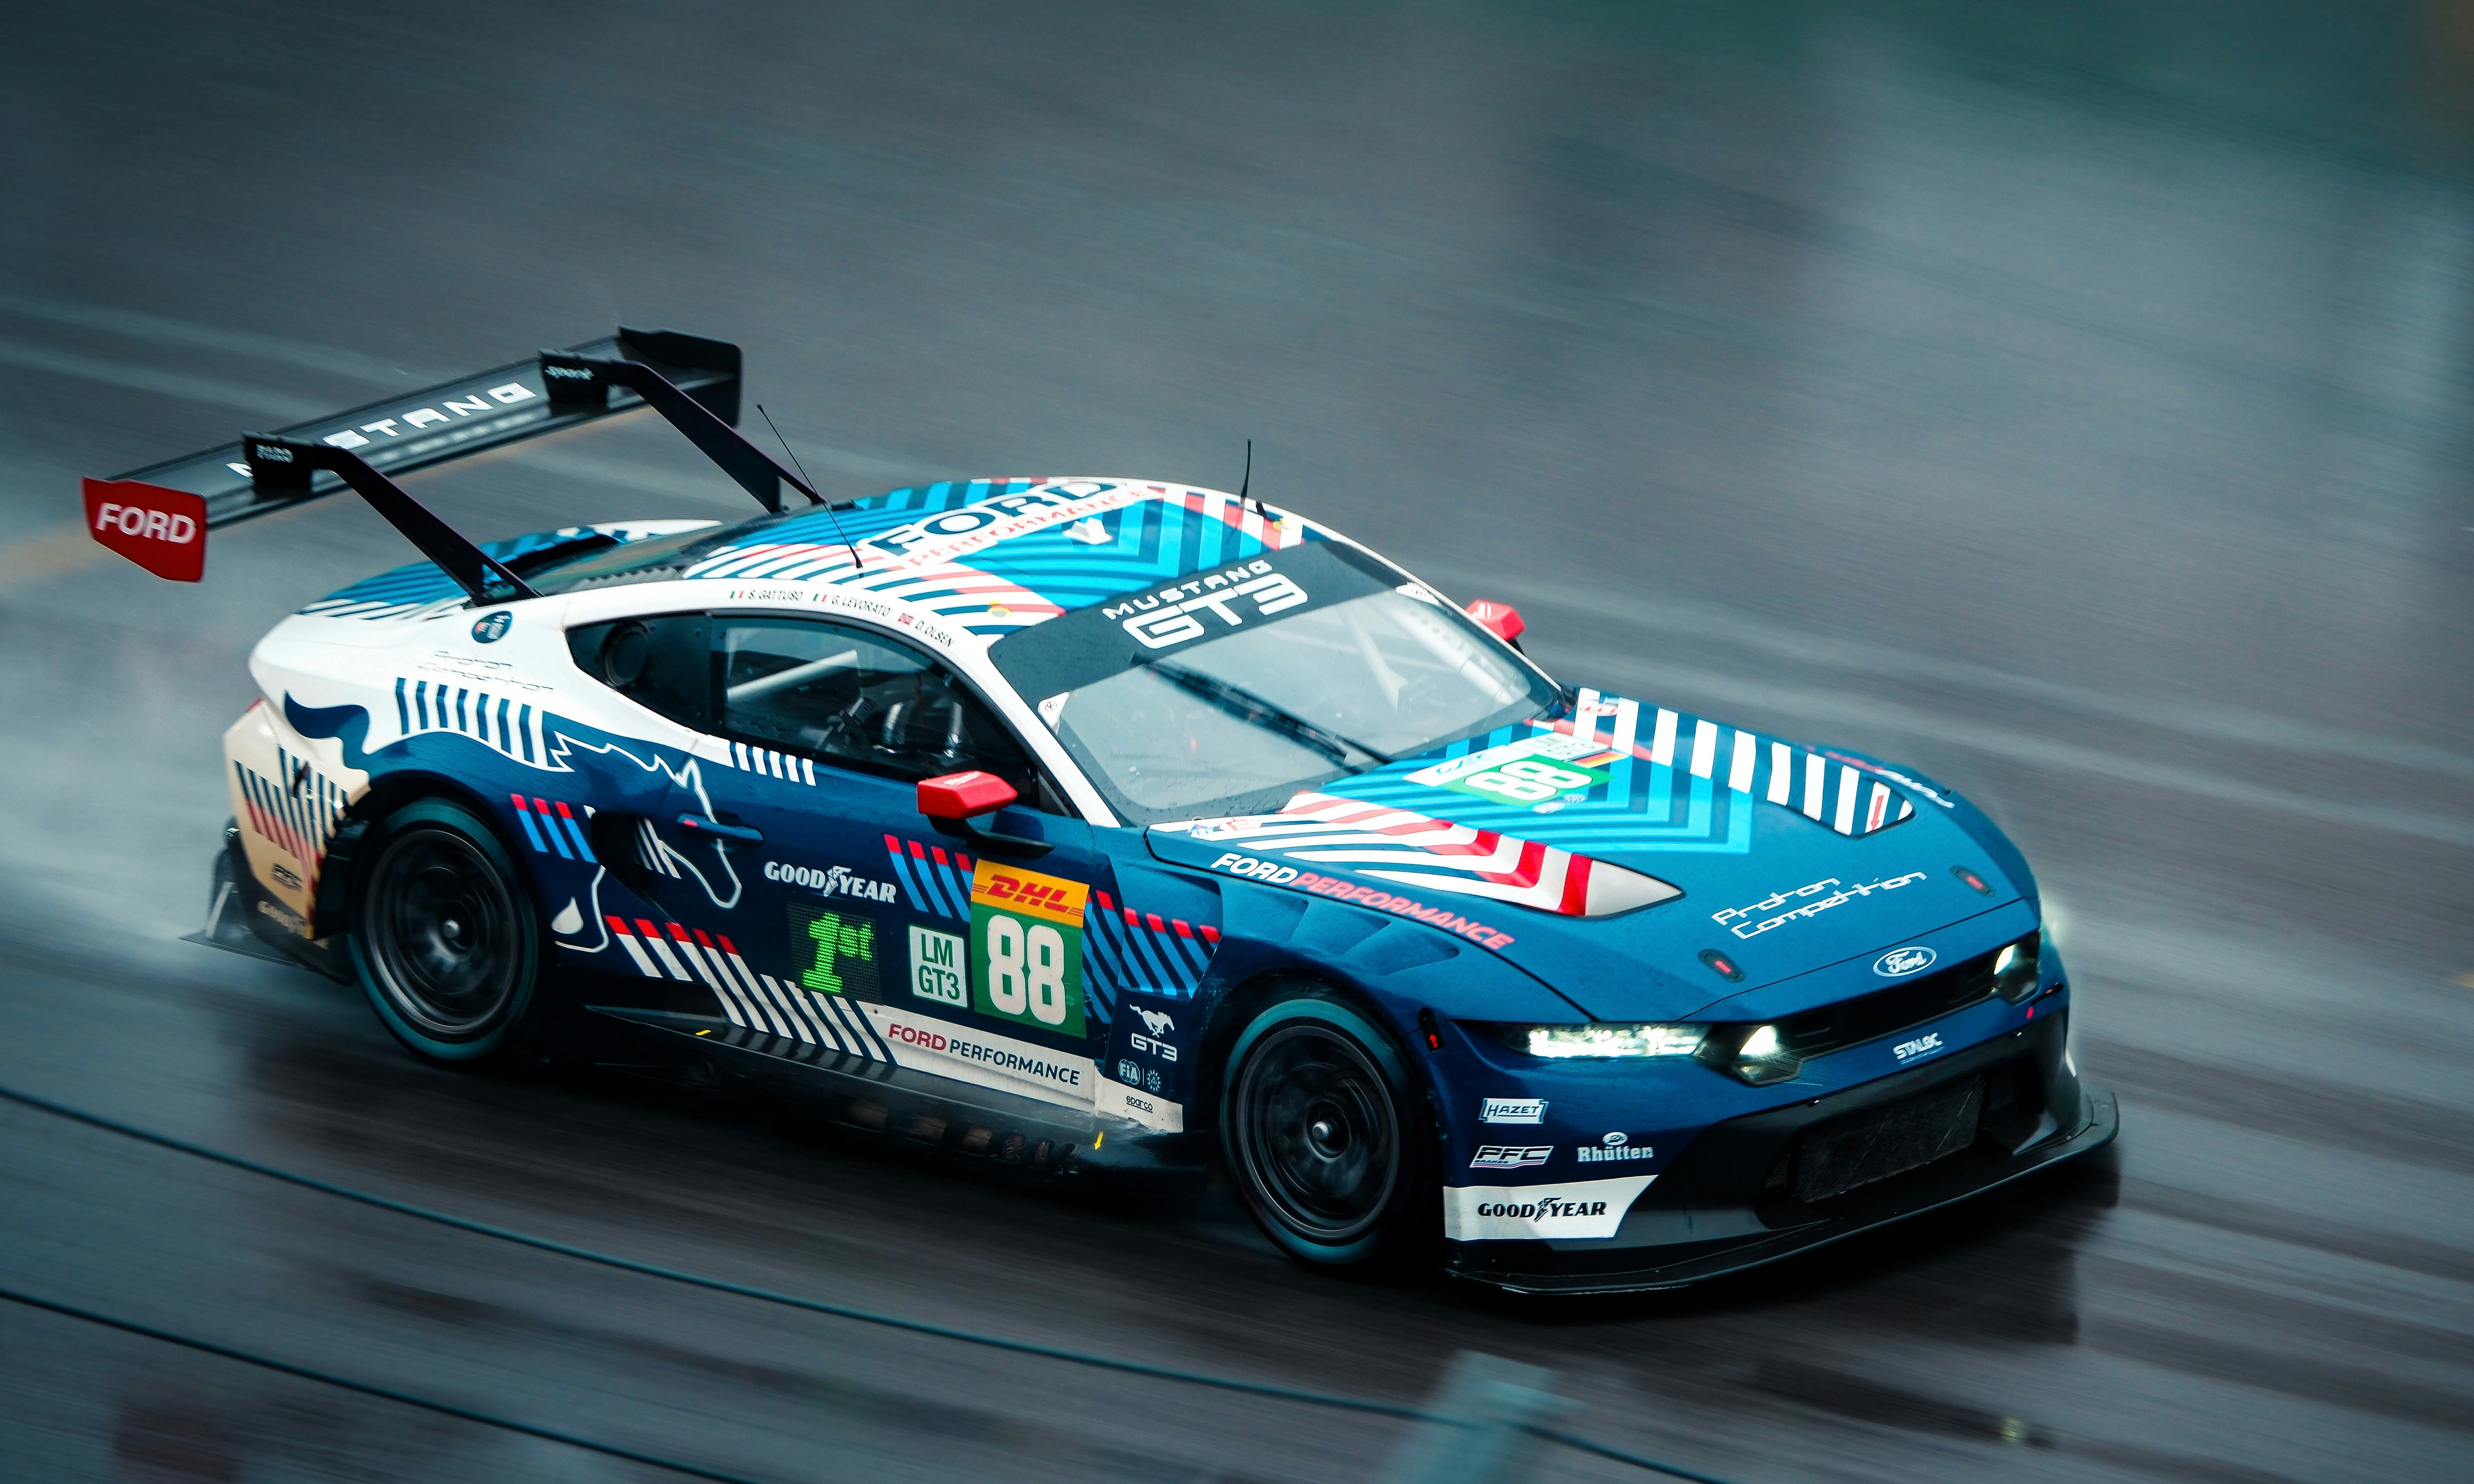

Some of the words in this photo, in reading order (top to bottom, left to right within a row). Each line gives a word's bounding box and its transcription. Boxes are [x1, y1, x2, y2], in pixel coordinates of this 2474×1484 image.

[95, 502, 197, 544] FORD
[868, 482, 1119, 556] FORD
[909, 490, 1148, 566] PERFORMANCE
[1102, 559, 1272, 620] MUSTANG
[1122, 573, 1308, 649] GT3
[925, 625, 955, 648] OLSEN
[1463, 760, 1593, 801] 88
[987, 874, 1070, 913] DHL
[1210, 852, 1298, 884] FORD
[1289, 872, 1515, 949] PERFORMANCE
[1711, 878, 1841, 926] Proton
[1730, 872, 1927, 939] Competition
[921, 933, 953, 968] LM
[987, 914, 1066, 1025] 88
[1885, 950, 1927, 973] Ford
[918, 965, 960, 1000] GT3
[888, 1023, 946, 1051] FORD
[949, 1039, 1080, 1086] PERFORMANCE
[1131, 1033, 1177, 1062] GT3
[1126, 1095, 1153, 1111] sparco
[1487, 1104, 1540, 1117] HAZET
[1475, 1146, 1551, 1160] PFC
[1478, 1201, 1607, 1219] GOODYEAR
